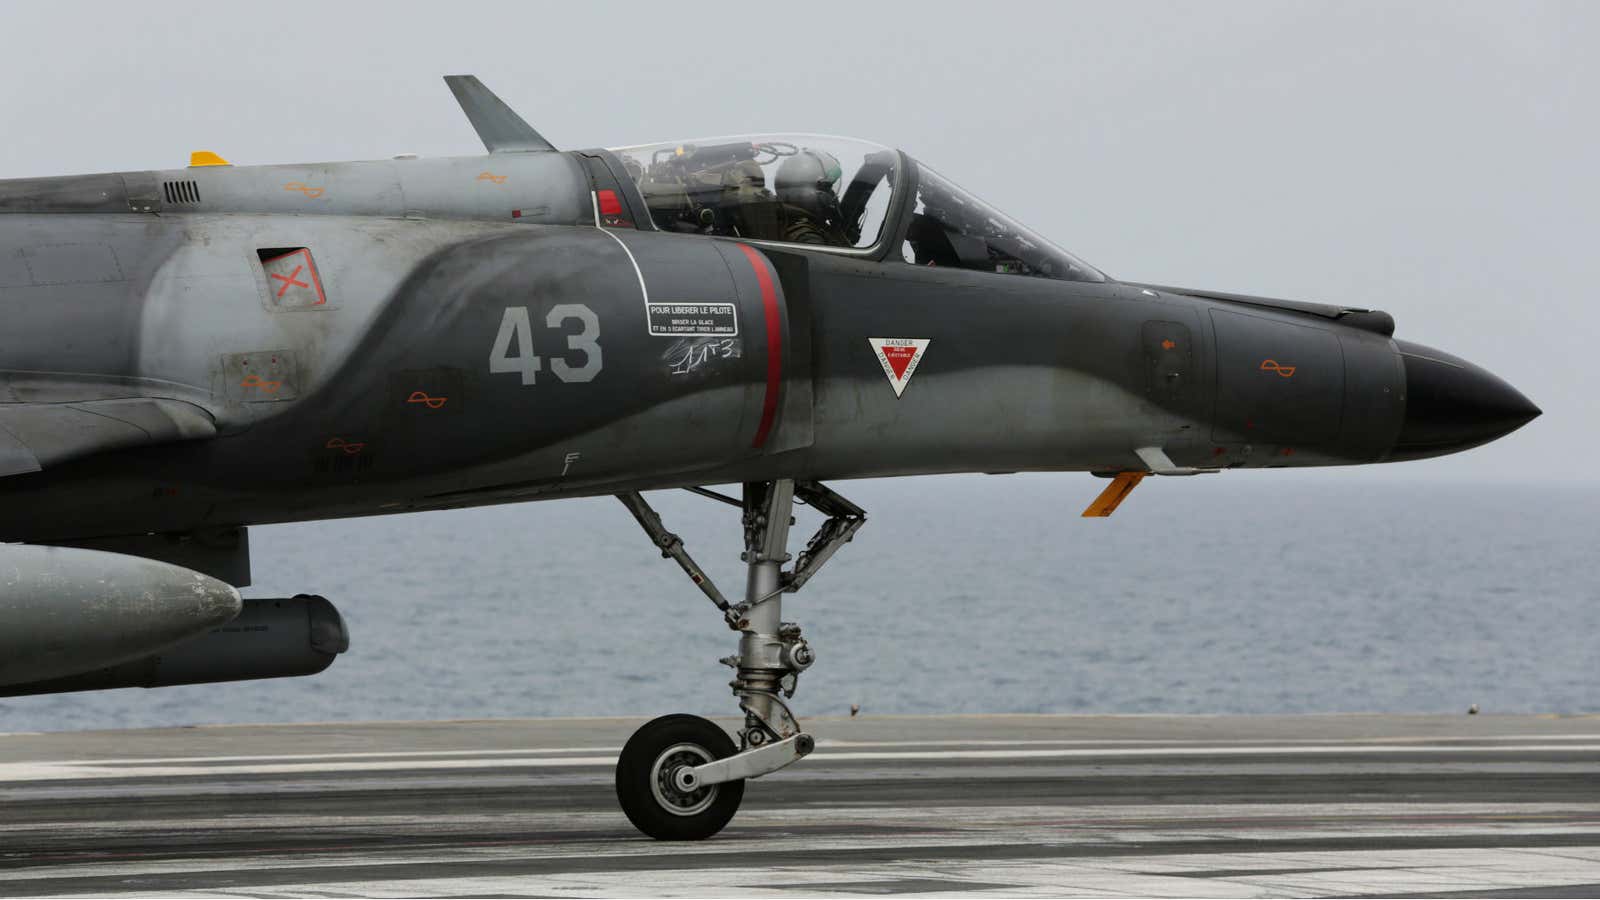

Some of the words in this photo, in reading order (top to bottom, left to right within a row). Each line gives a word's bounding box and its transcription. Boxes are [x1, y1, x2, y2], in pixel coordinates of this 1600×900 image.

[651, 306, 670, 314] POUR
[671, 306, 699, 314] LIBERER
[700, 306, 709, 314] LE
[709, 306, 732, 314] PILOTE
[489, 304, 603, 385] 43
[902, 352, 920, 381] DANGER
